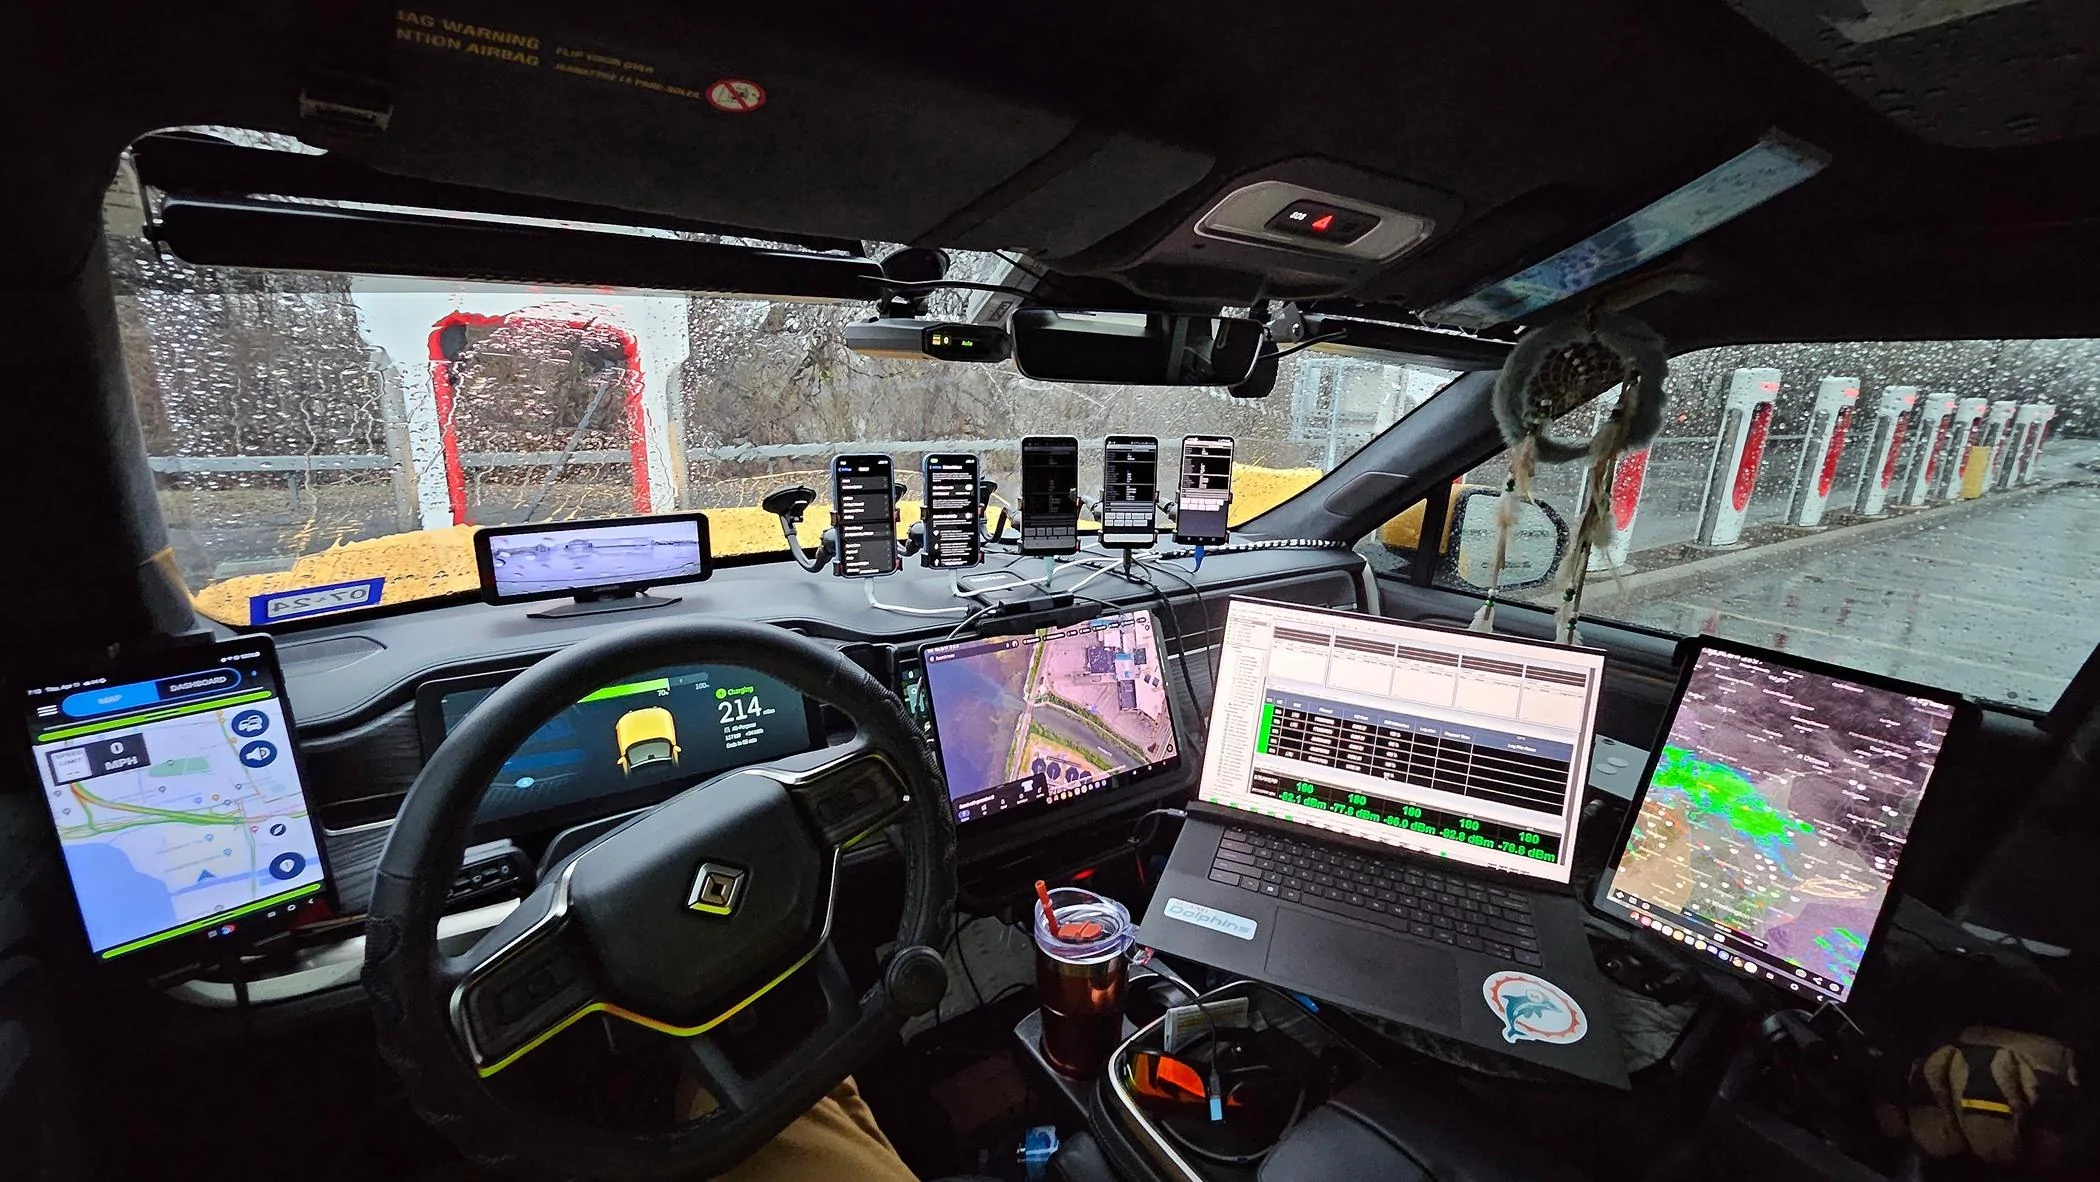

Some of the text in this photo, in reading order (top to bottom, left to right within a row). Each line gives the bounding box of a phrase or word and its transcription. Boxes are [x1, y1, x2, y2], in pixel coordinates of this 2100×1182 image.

[441, 18, 542, 51] WARNING
[464, 42, 541, 67] AIRBAG
[169, 675, 228, 692] DASHBOARD
[727, 685, 754, 697] Charging
[717, 695, 762, 725] 214
[104, 755, 138, 771] MPH
[1303, 797, 1327, 809] dBm
[1355, 809, 1380, 822] dBm
[1410, 821, 1436, 834] dBm
[1467, 835, 1494, 848] dBm
[1528, 848, 1556, 862] dBm
[1402, 806, 1422, 818] 180
[1459, 818, 1479, 830] 180
[1519, 832, 1540, 844] 180
[1169, 905, 1251, 933] Dolphins
